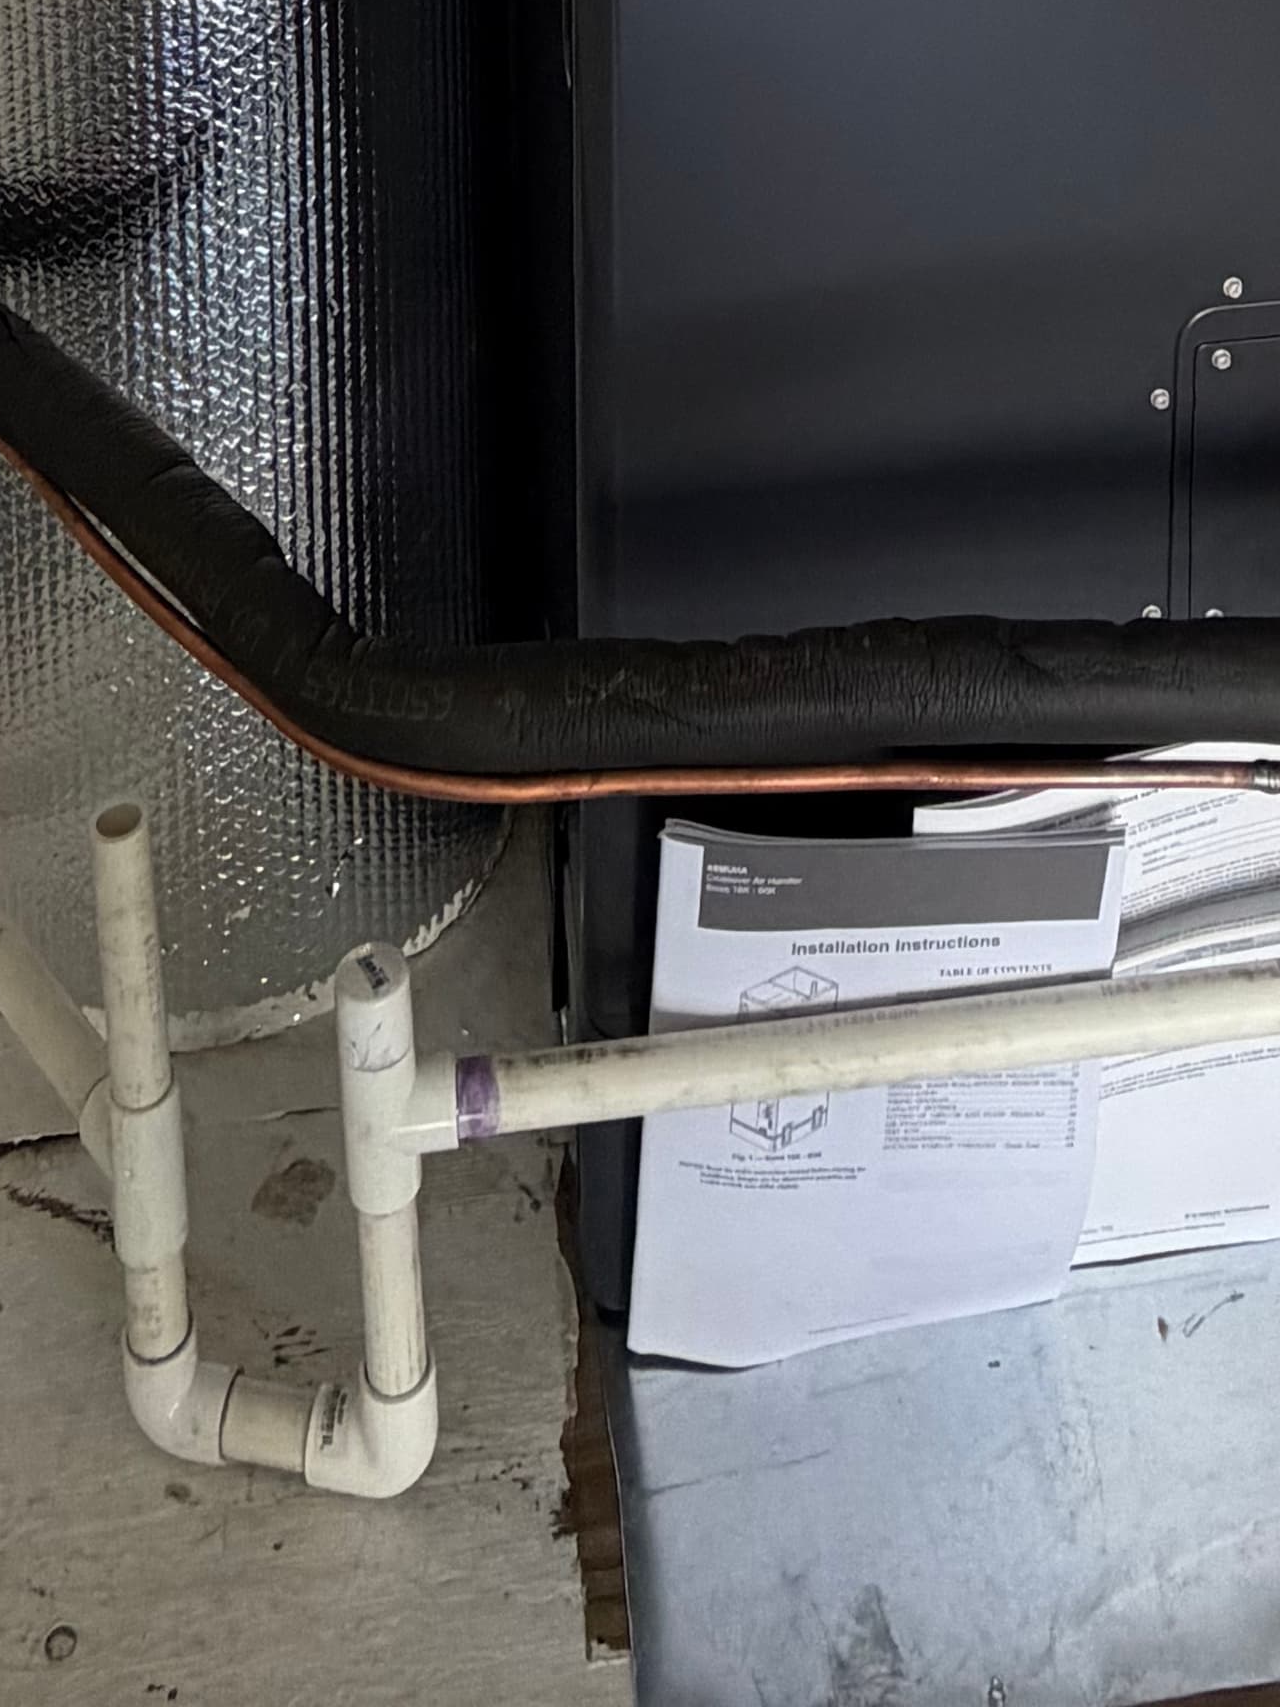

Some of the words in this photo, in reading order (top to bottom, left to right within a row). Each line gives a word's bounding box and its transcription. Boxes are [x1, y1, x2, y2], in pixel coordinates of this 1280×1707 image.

[791, 939, 890, 957] Installation
[895, 935, 1002, 954] Instructions
[939, 967, 973, 978] TABLE
[976, 966, 989, 977] OF
[993, 963, 1053, 976] CONTENTS
